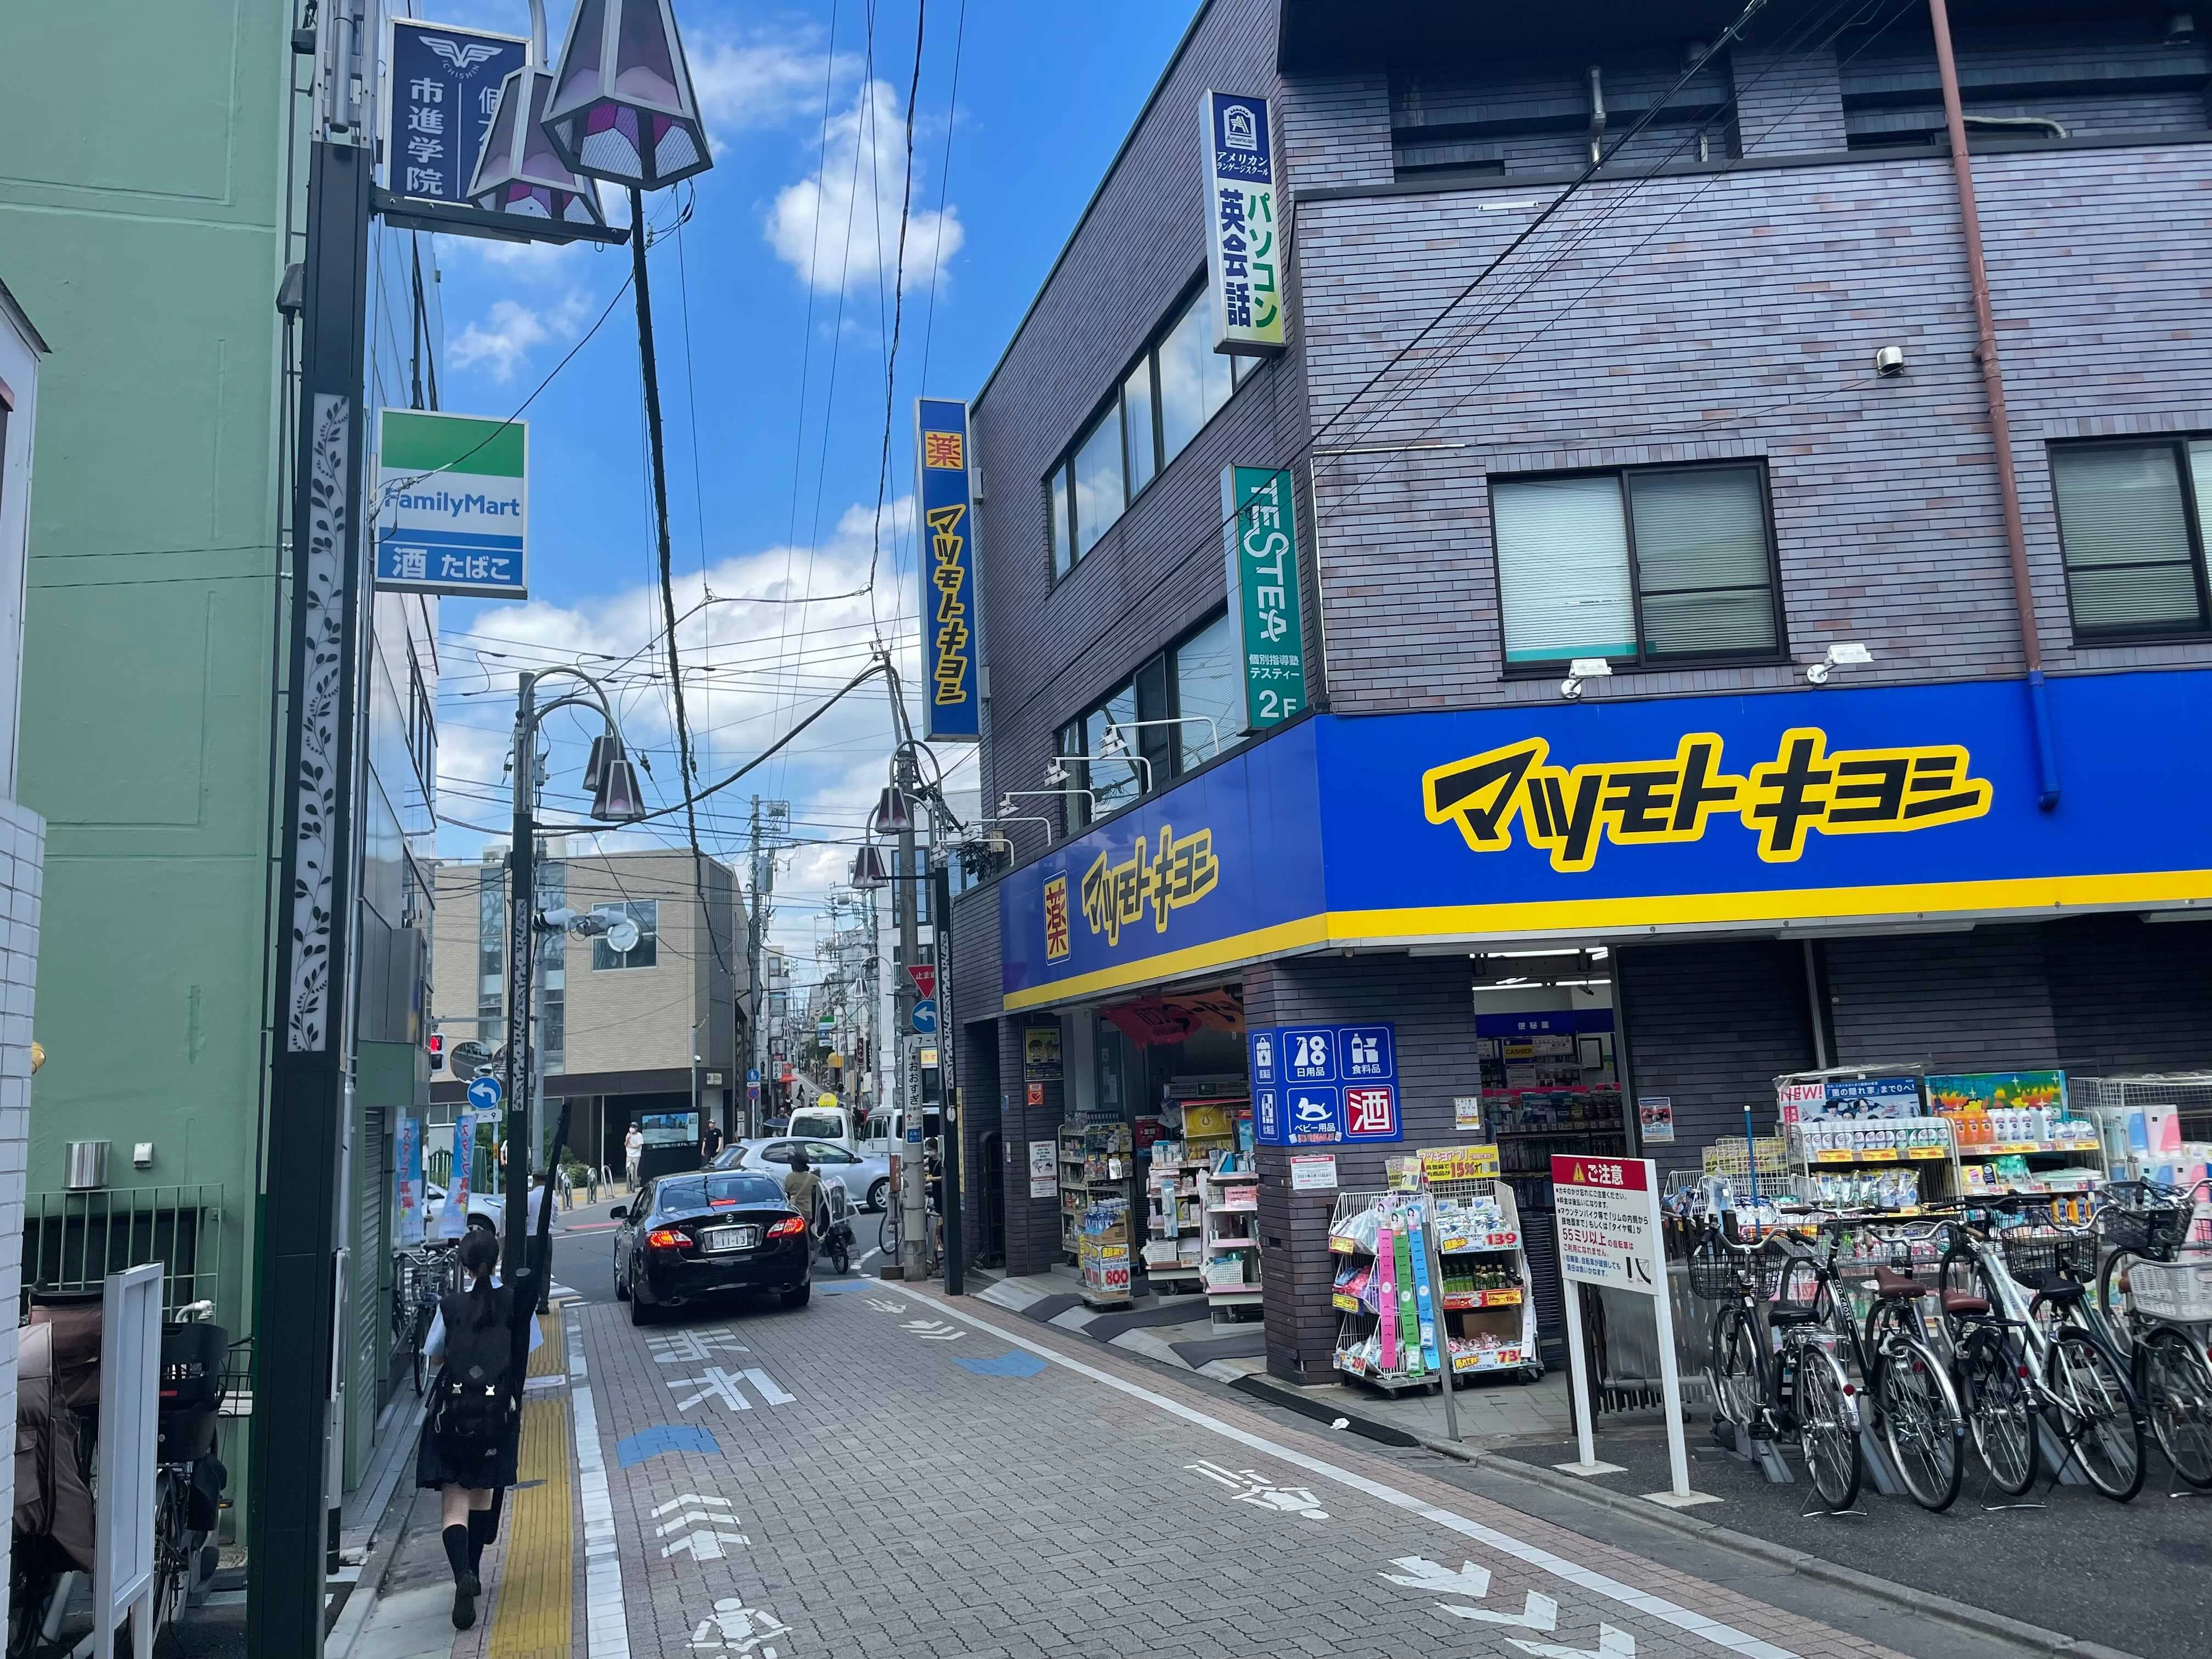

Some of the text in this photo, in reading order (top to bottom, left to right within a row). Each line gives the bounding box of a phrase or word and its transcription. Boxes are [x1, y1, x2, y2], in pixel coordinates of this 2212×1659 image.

[442, 59, 481, 80] ICHISHIN
[405, 76, 445, 196] 市進学院
[1226, 134, 1256, 145] American
[1216, 151, 1268, 166] アメリカン
[1216, 162, 1269, 176] ランゲージスクール
[1220, 187, 1252, 328] 英会話
[1246, 191, 1278, 329] パソコン
[927, 433, 962, 468] 薬
[385, 487, 521, 518] FamilyMart
[391, 546, 511, 580] 酒 たばこ
[1243, 477, 1289, 643] TESTEA
[927, 504, 969, 705] マツモトキヨシ
[1249, 653, 1300, 667] 個別指導塾
[1250, 667, 1300, 680] テスティー
[1259, 689, 1297, 719] 2F
[1423, 726, 1994, 874] マツモトキヨシ
[1081, 823, 1219, 947] マツモトキヨシ
[1046, 882, 1067, 956] 薬
[1296, 1067, 1325, 1077] 日用品
[1351, 1064, 1381, 1075] 食料品
[909, 1062, 919, 1105] おおすぎ
[1781, 1085, 1823, 1102] NEW!
[1349, 1091, 1390, 1131] 酒
[1294, 1122, 1336, 1132] ベビー用品
[1587, 1164, 1624, 1186] ご注意
[721, 1235, 746, 1246] 11-13
[1485, 1232, 1518, 1246] 139
[1105, 1268, 1129, 1286] 800
[1834, 1279, 1852, 1321] GEO CROSS
[1497, 1350, 1522, 1364] 73
